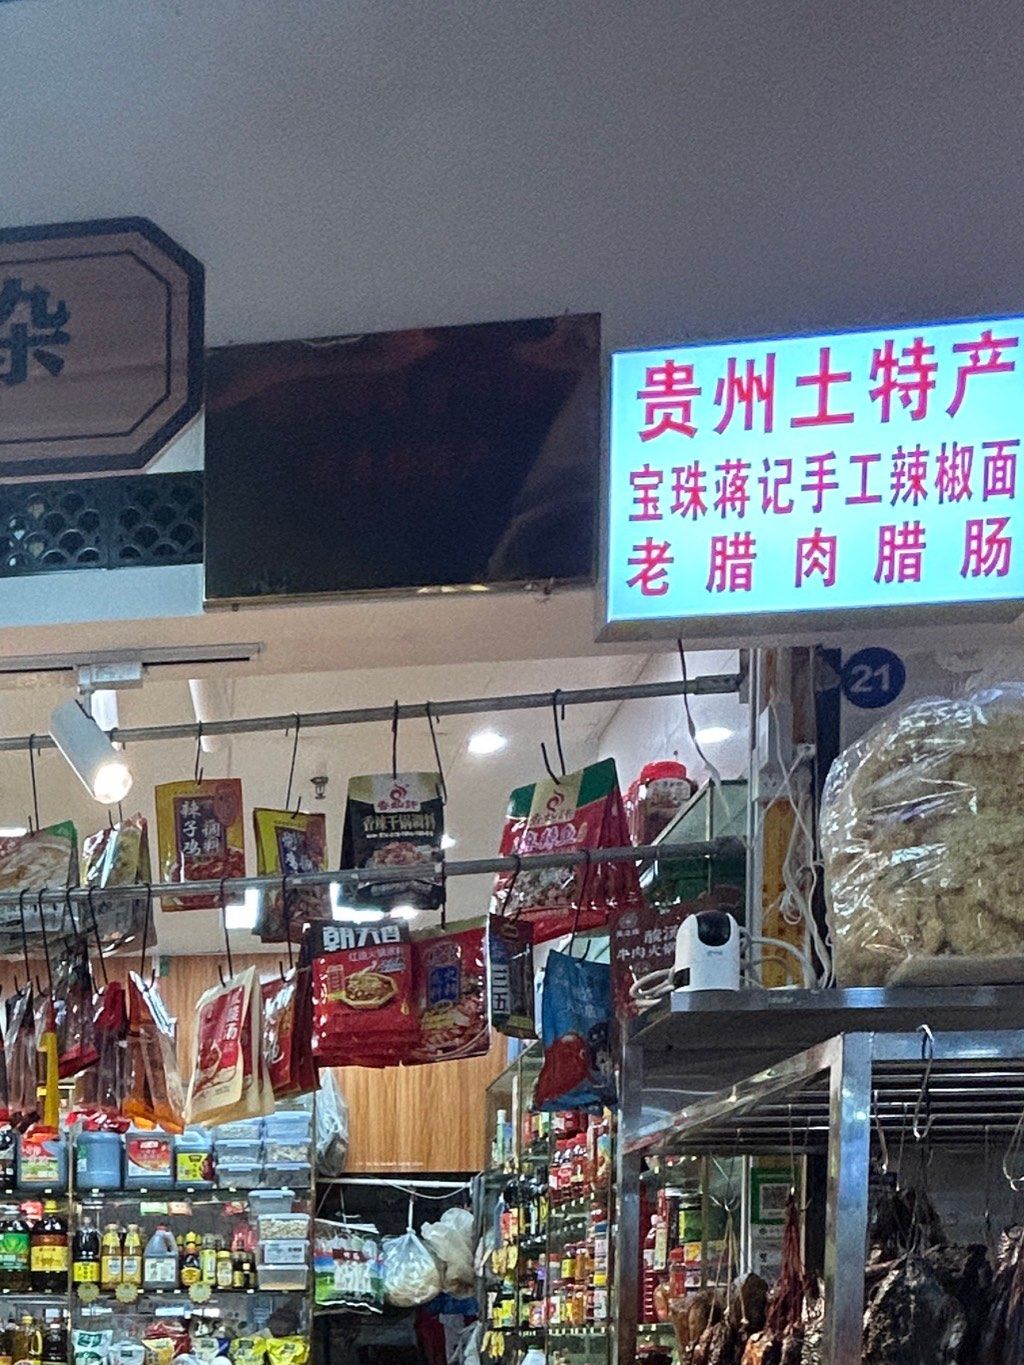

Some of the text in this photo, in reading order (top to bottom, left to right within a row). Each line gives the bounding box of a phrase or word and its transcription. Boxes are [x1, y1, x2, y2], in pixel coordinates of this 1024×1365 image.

[636, 330, 1019, 442] 贵州土特产
[628, 439, 1021, 522] 宝珠蒋记手工辣椒面
[626, 516, 1012, 597] 老腊肉腊肠
[849, 664, 893, 694] 21
